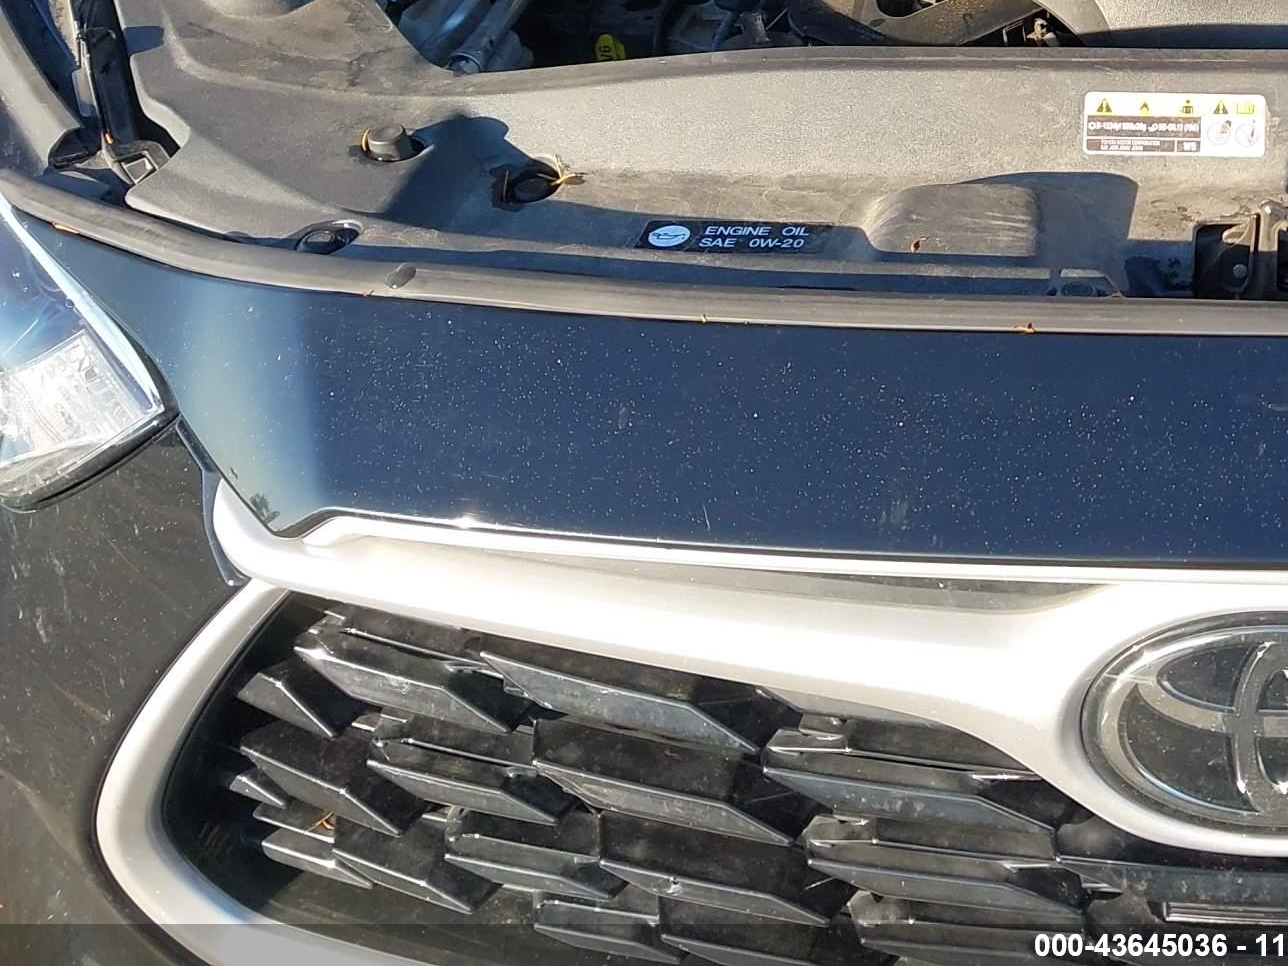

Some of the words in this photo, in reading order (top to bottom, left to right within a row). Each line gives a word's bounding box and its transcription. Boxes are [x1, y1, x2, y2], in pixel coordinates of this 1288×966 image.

[704, 226, 772, 236] ENGINE
[782, 226, 809, 236] OIL
[698, 237, 737, 248] SAE
[748, 238, 804, 248] 0W-20
